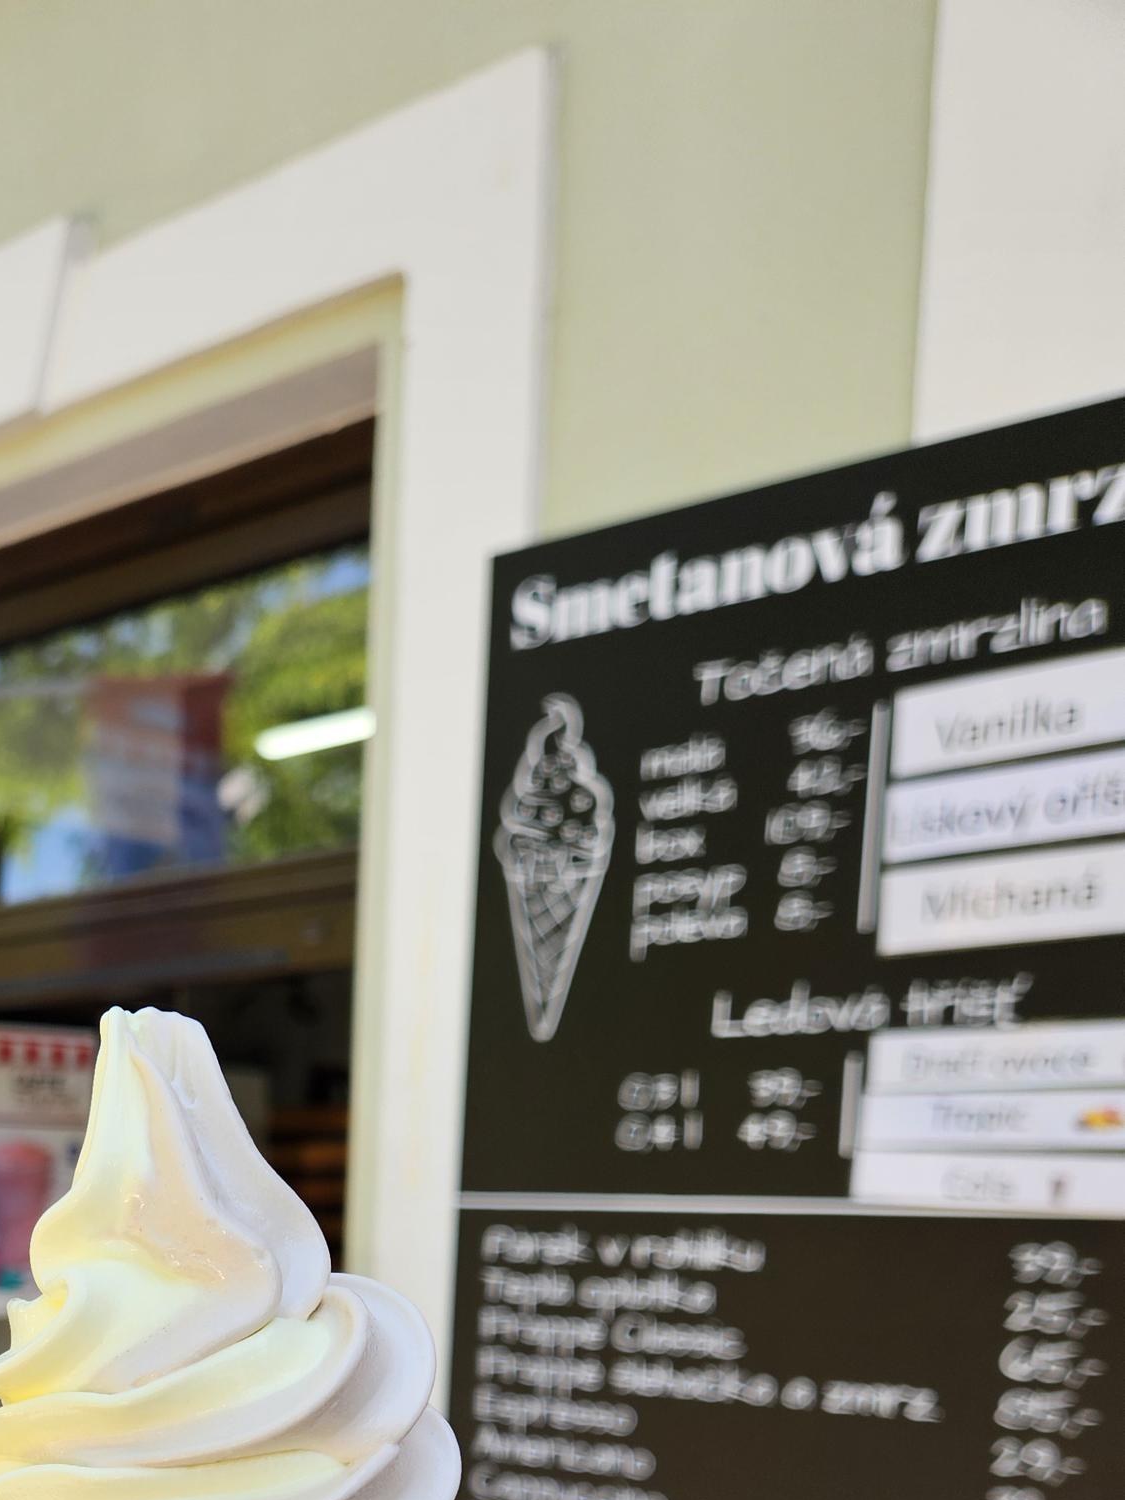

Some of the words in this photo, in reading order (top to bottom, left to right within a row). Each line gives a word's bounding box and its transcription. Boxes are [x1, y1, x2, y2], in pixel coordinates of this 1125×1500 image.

[510, 490, 906, 651] Smetanová
[693, 632, 874, 705] Točená
[885, 599, 1108, 673] zmrzlina
[935, 698, 1084, 751] Vanilka
